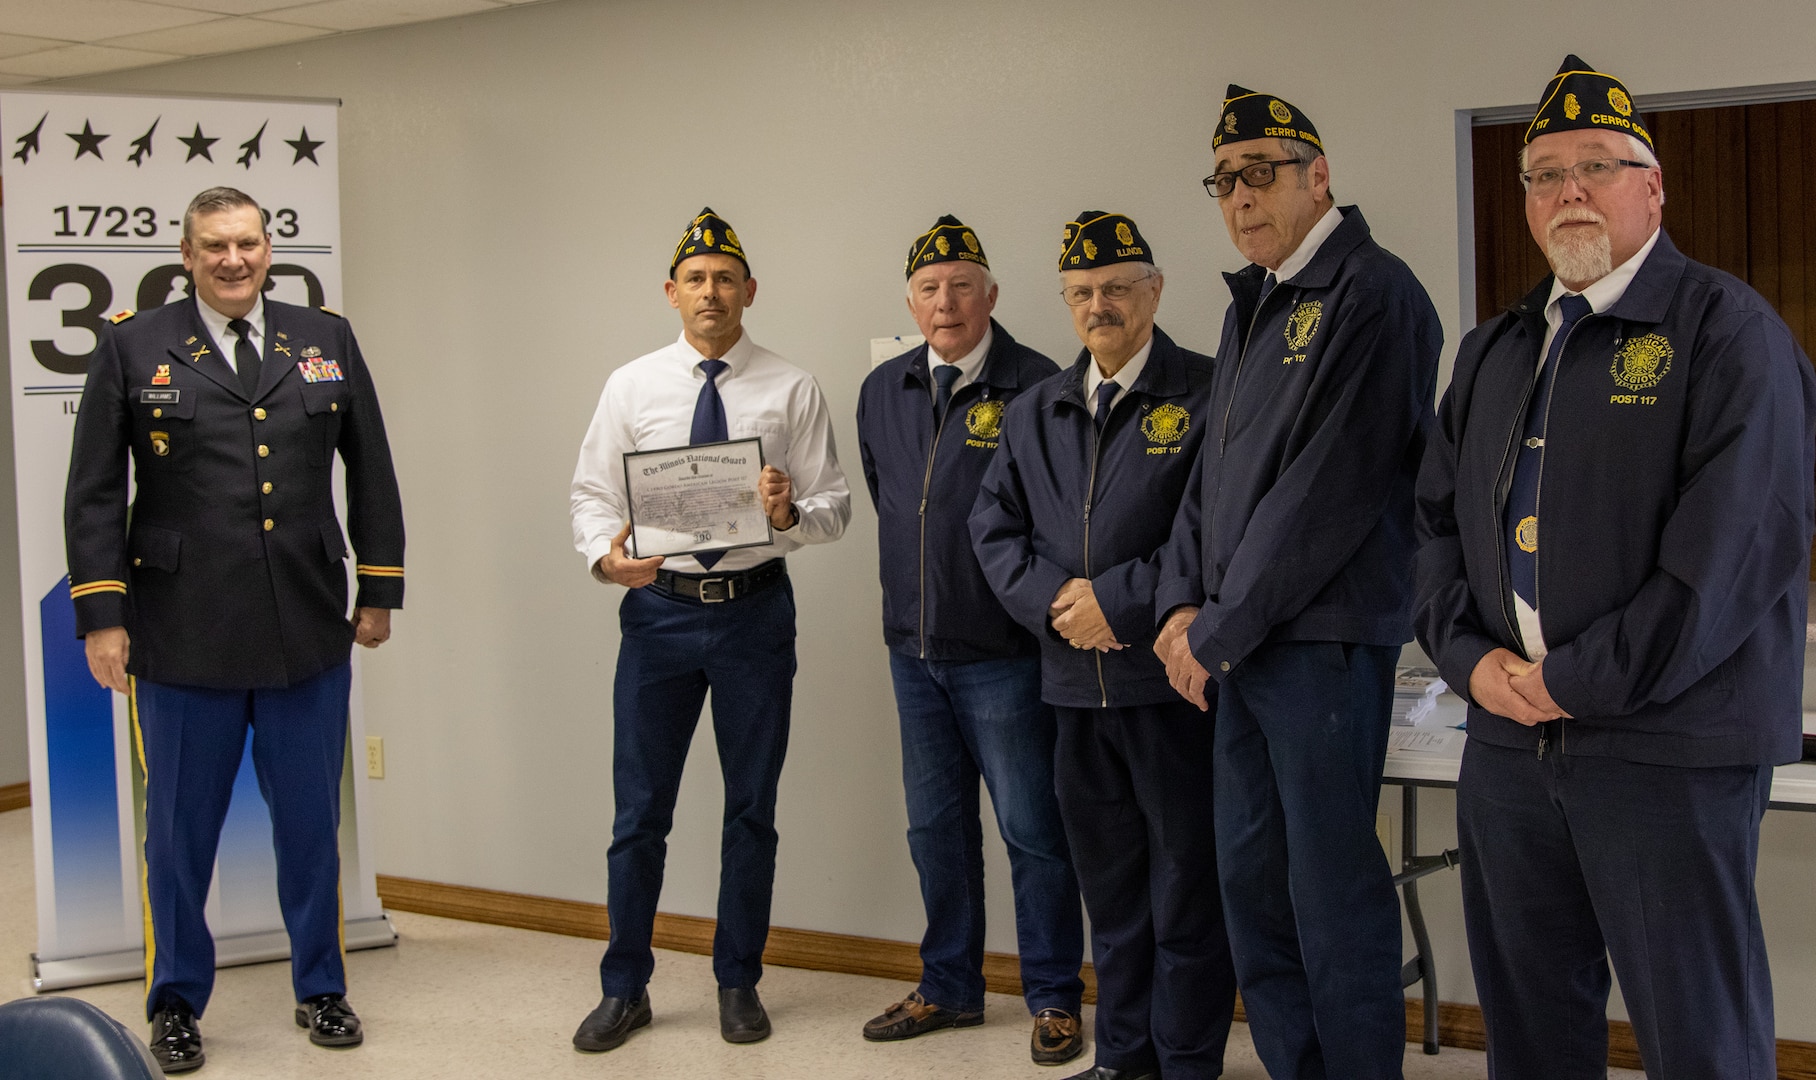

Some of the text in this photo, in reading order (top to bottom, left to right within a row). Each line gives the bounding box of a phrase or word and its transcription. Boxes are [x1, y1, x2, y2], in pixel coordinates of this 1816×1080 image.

[1536, 118, 1550, 130] 117
[1591, 114, 1630, 128] CERRO
[1264, 127, 1297, 138] CERRO
[54, 205, 157, 238] 1723
[923, 252, 935, 262] 117
[1116, 247, 1143, 257] ILLINOIS
[1621, 338, 1667, 358] AMERICAN
[1294, 354, 1307, 362] 117
[1619, 370, 1656, 384] LEGION
[1610, 395, 1657, 405] POST 117
[965, 439, 999, 449] POST 117
[1146, 446, 1182, 455] POST 117
[643, 454, 746, 476] The Illinois National Guard
